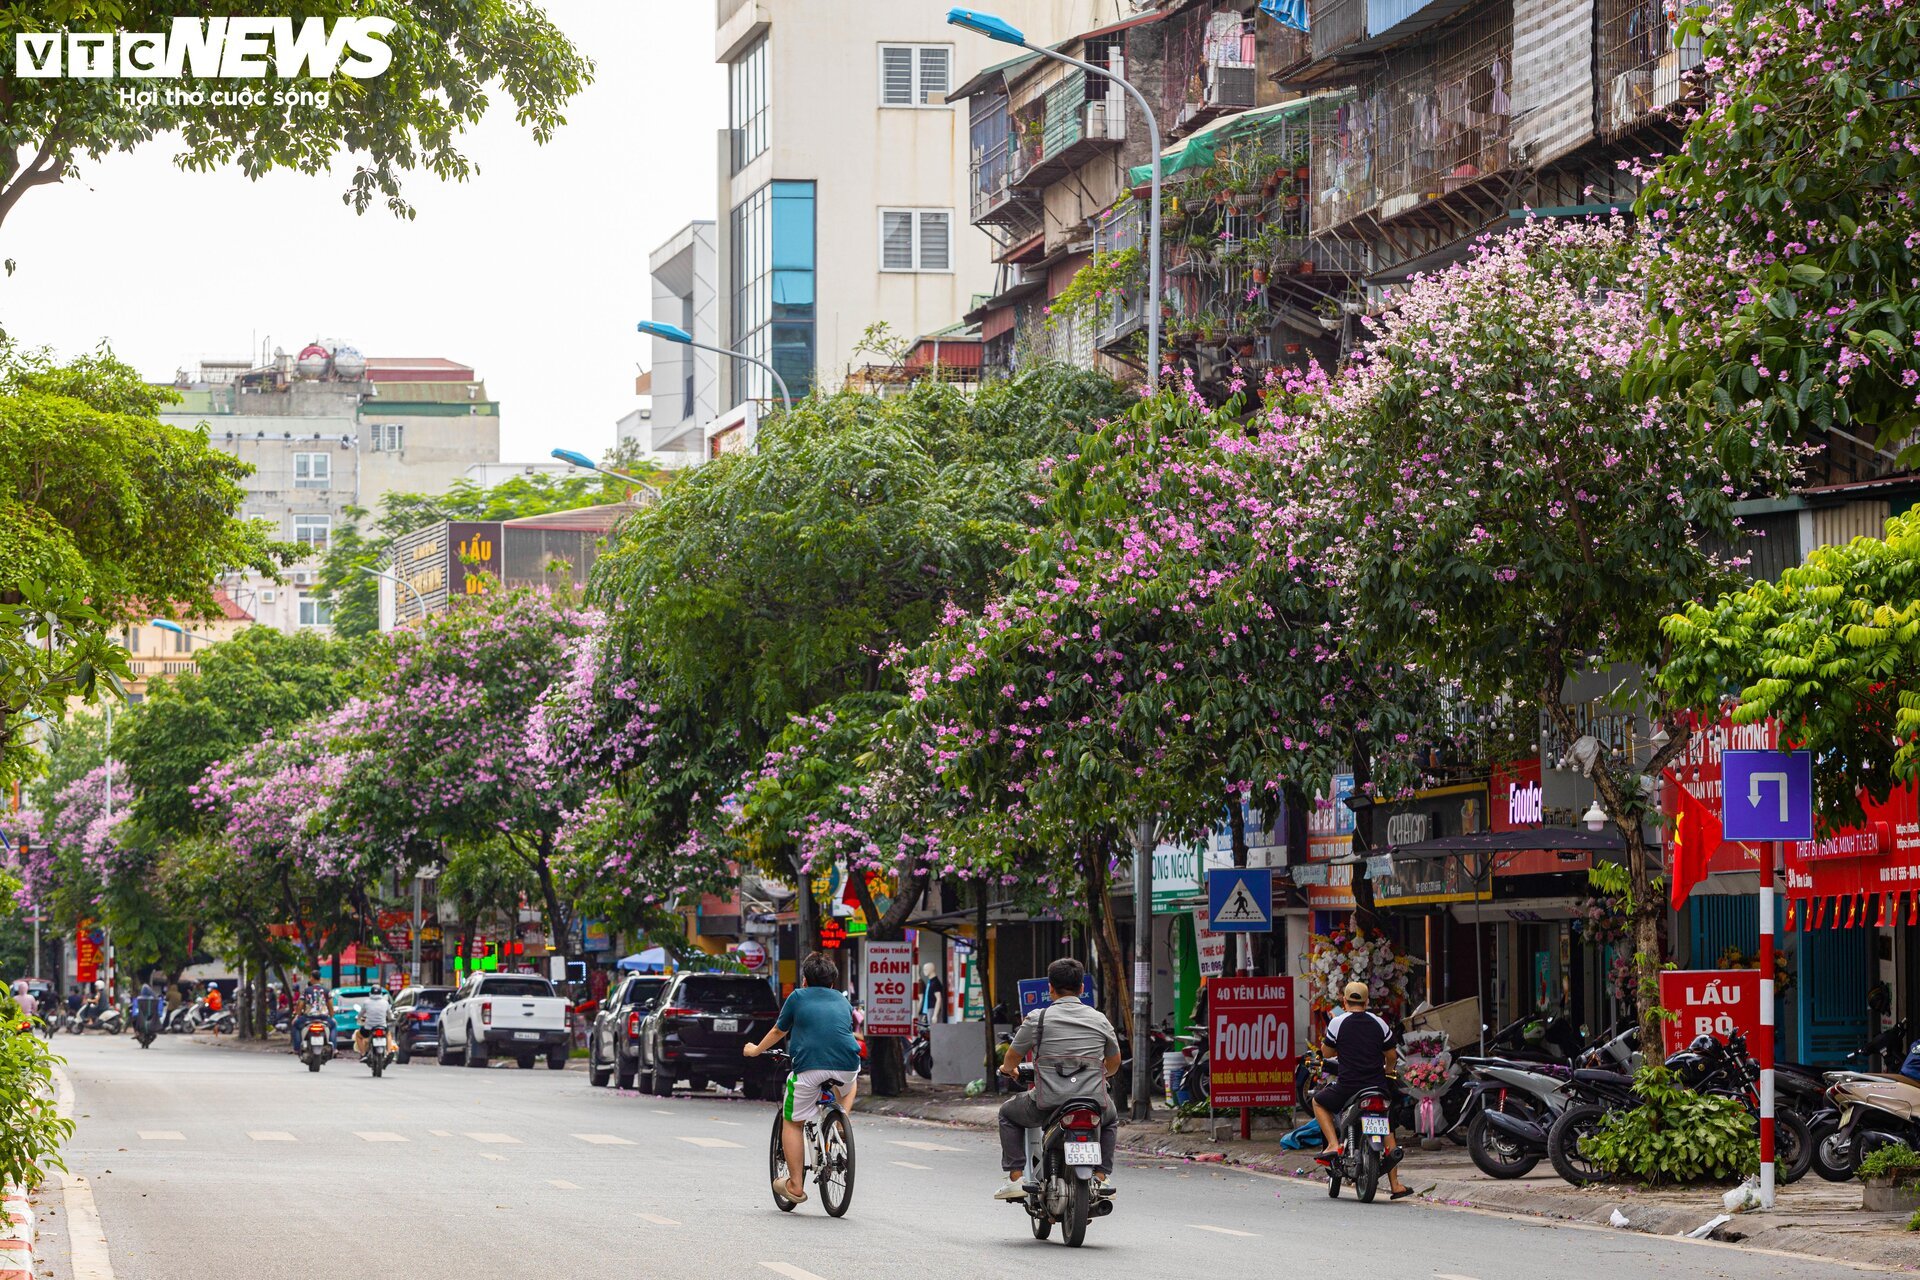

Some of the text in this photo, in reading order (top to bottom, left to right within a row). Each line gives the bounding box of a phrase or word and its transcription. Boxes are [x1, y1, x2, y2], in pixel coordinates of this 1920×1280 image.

[461, 533, 491, 561] LẨU
[1388, 814, 1427, 845] CHAGO
[1839, 834, 1855, 853] MINH
[1171, 852, 1194, 883] NGỌC
[870, 957, 910, 974] BÁNH
[874, 978, 905, 995] XÈO
[1217, 985, 1286, 1000] 40 YÊN LÃNG
[1686, 979, 1740, 1005] LẨU
[1695, 1012, 1733, 1036] BÒ
[1215, 1013, 1289, 1061] FoodCo
[1068, 1154, 1099, 1163] 555.50
[1070, 1144, 1095, 1153] 29-L1
